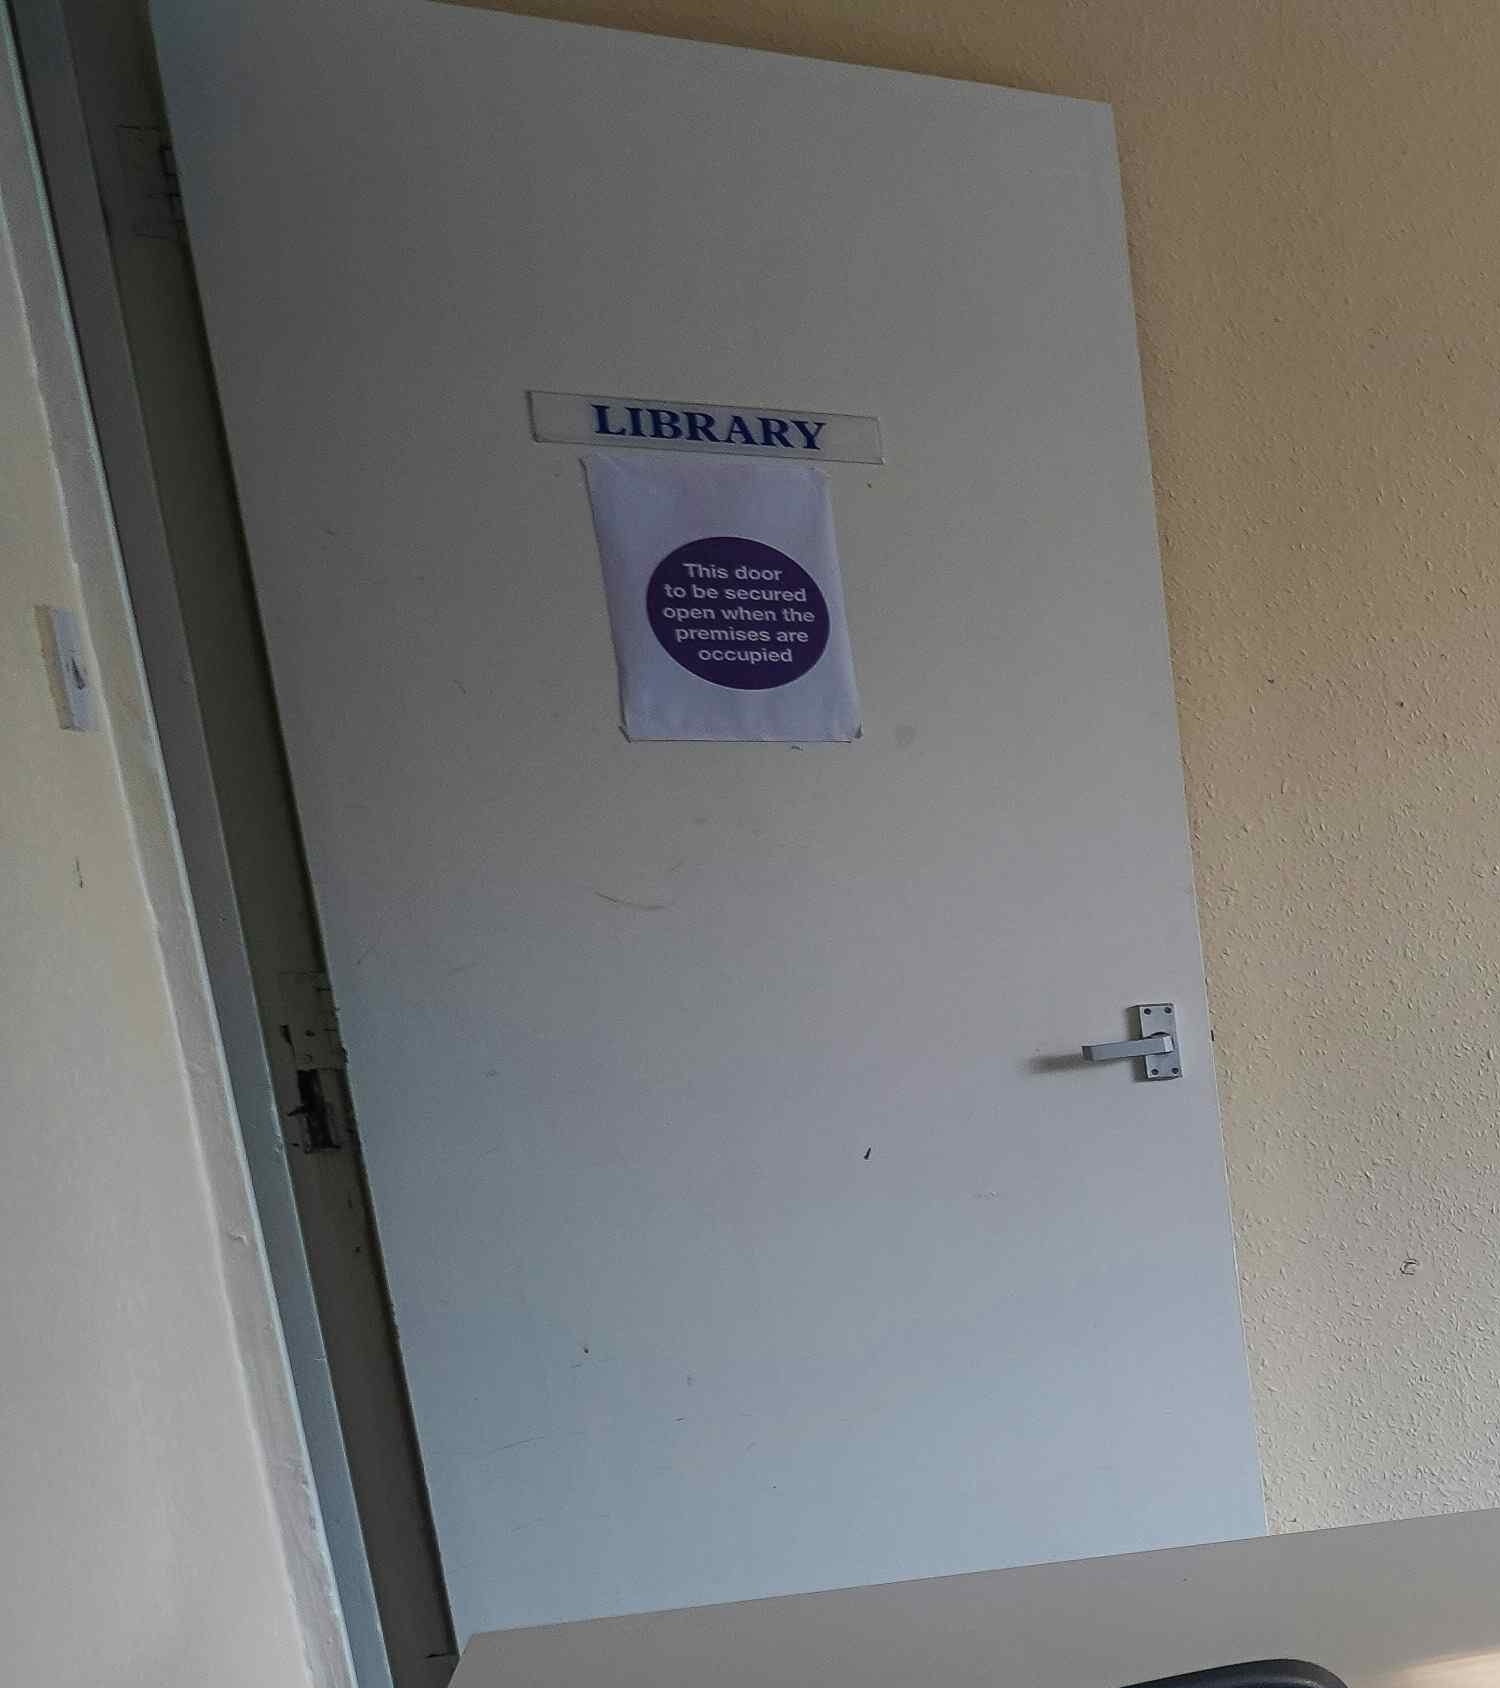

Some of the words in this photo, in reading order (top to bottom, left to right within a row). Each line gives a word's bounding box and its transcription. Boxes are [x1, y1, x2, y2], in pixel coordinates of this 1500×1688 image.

[590, 404, 828, 450] LIBRARY
[683, 562, 728, 581] This
[735, 565, 783, 581] door
[664, 585, 687, 600] to
[694, 585, 718, 600] be
[725, 587, 807, 603] secured
[663, 607, 715, 623] open
[721, 607, 776, 622] when
[782, 608, 815, 624] the
[674, 627, 771, 643] premises
[777, 630, 809, 643] are
[698, 647, 793, 665] occupied
